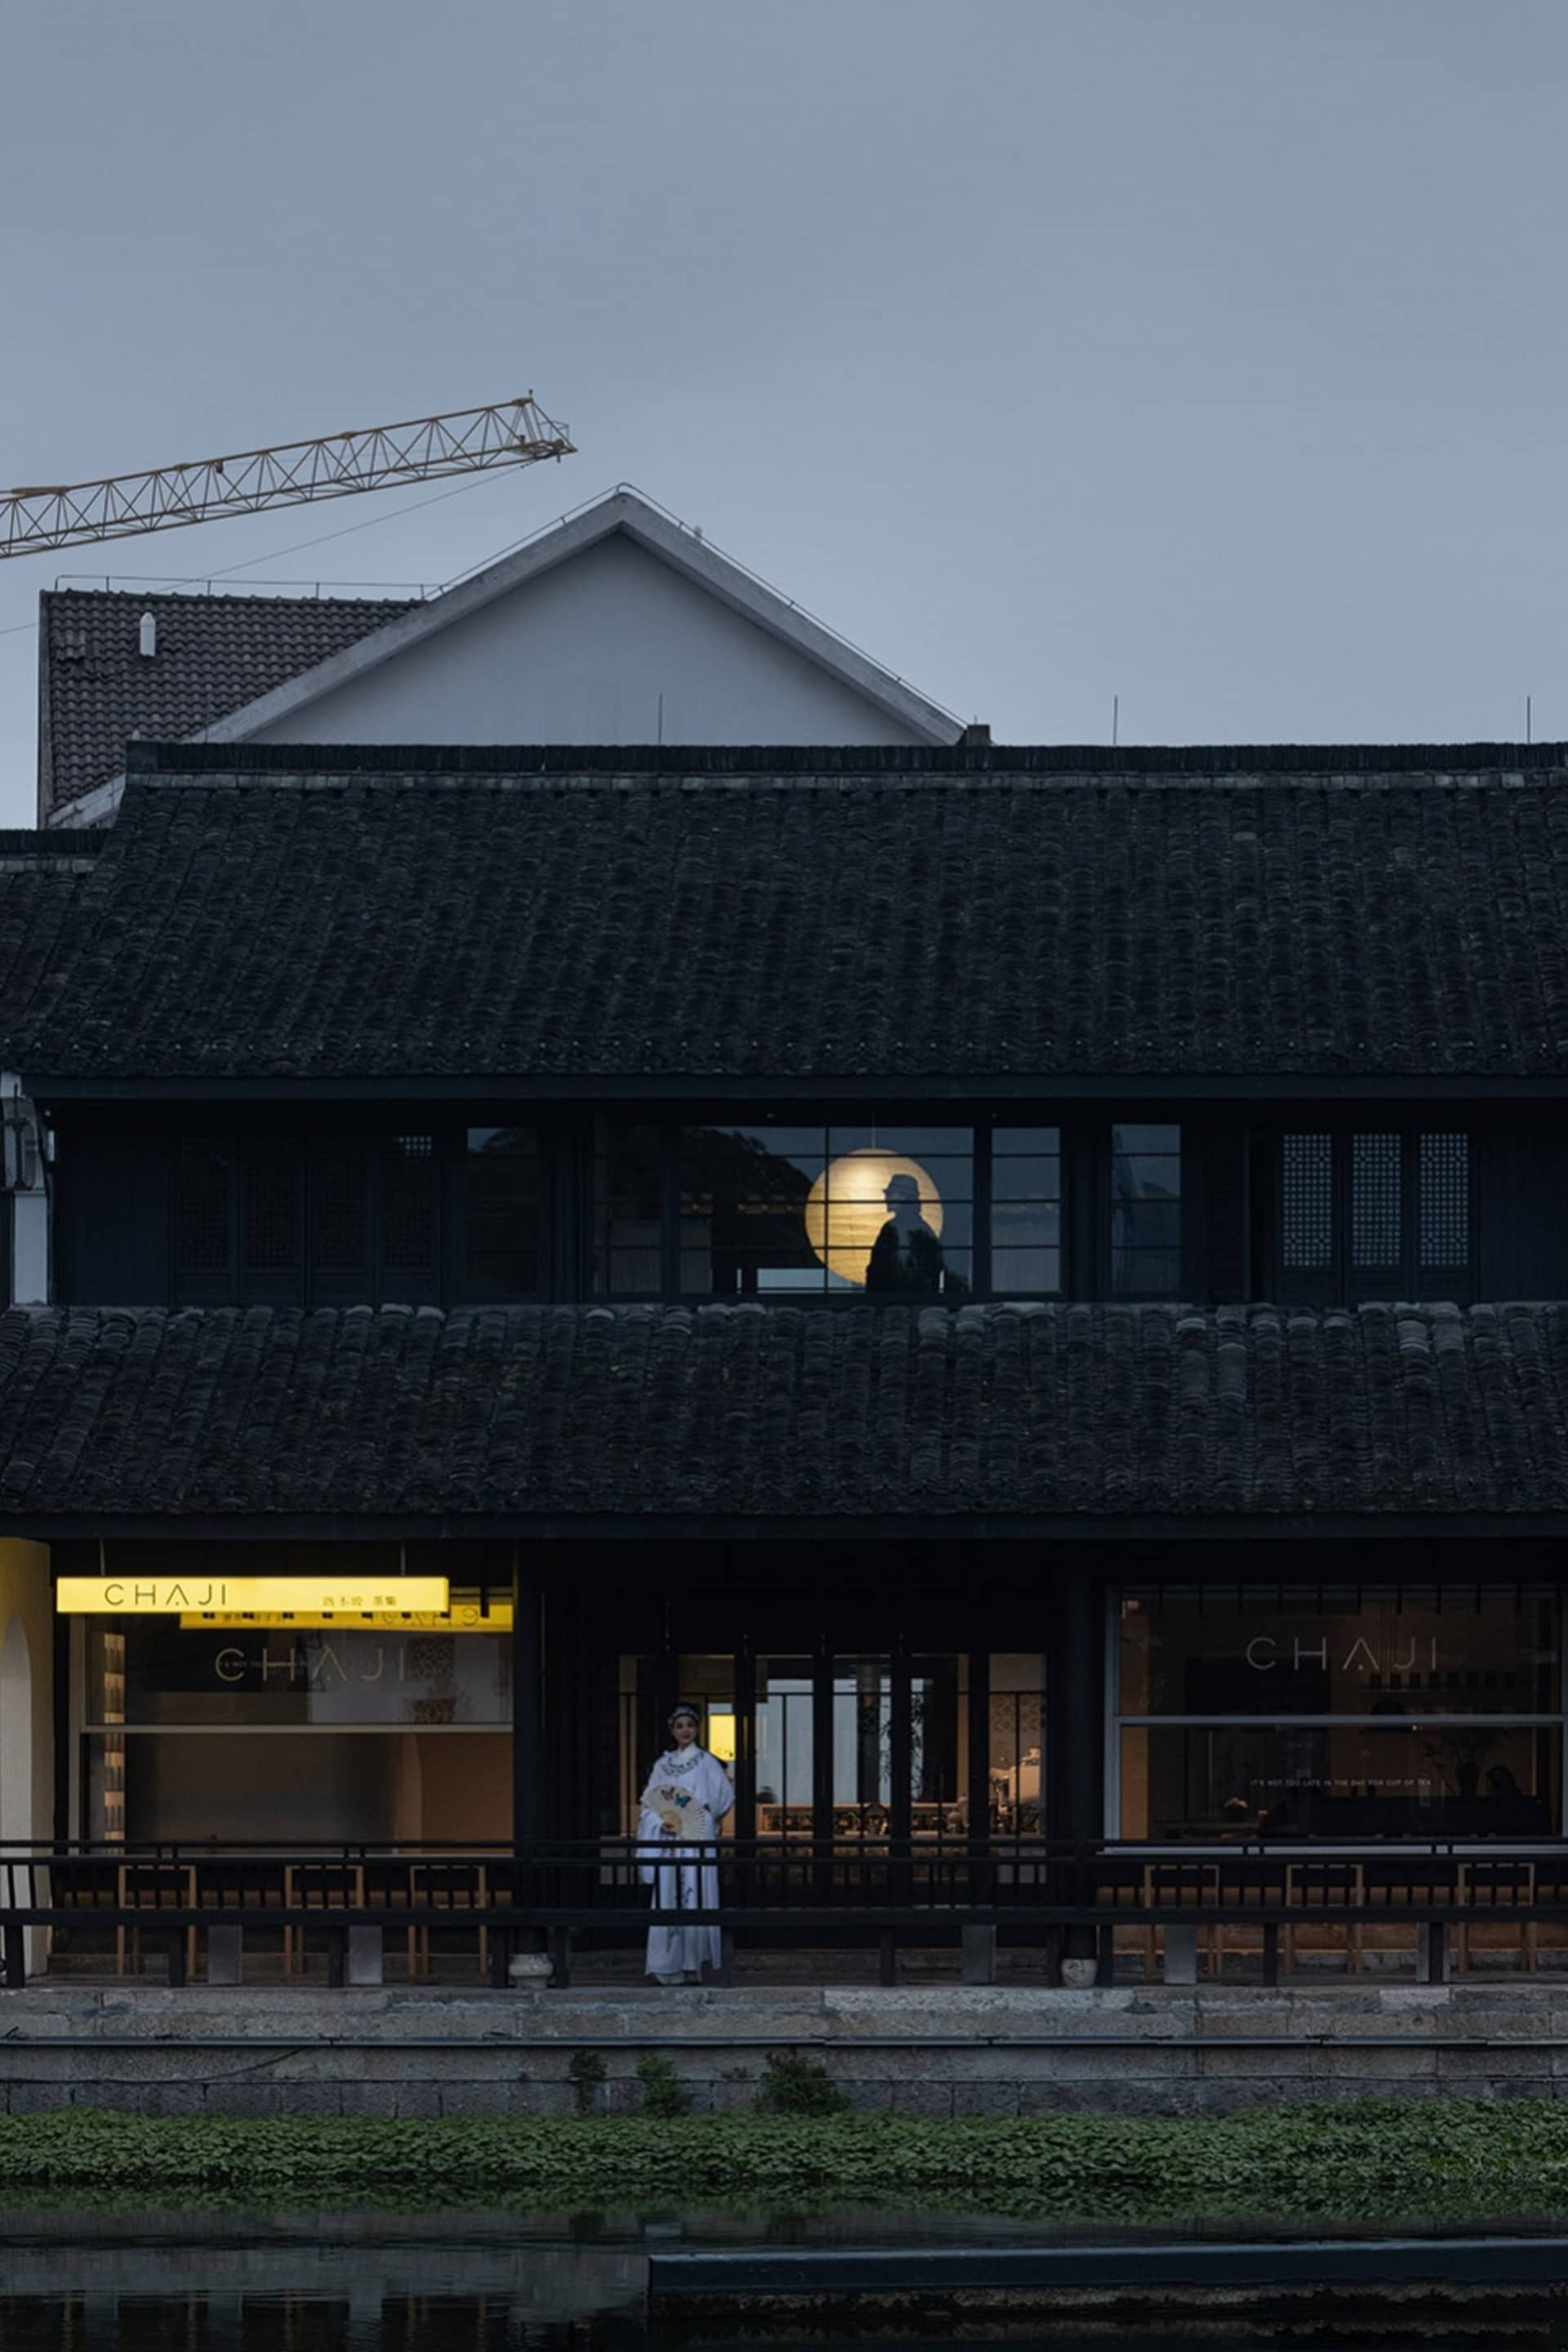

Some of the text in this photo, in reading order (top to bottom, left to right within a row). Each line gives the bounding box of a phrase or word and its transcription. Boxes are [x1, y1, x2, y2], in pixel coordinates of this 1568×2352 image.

[105, 1584, 226, 1606] CHAJI
[215, 1645, 405, 1681] CHAJI
[1246, 1635, 1437, 1671] CHAJI
